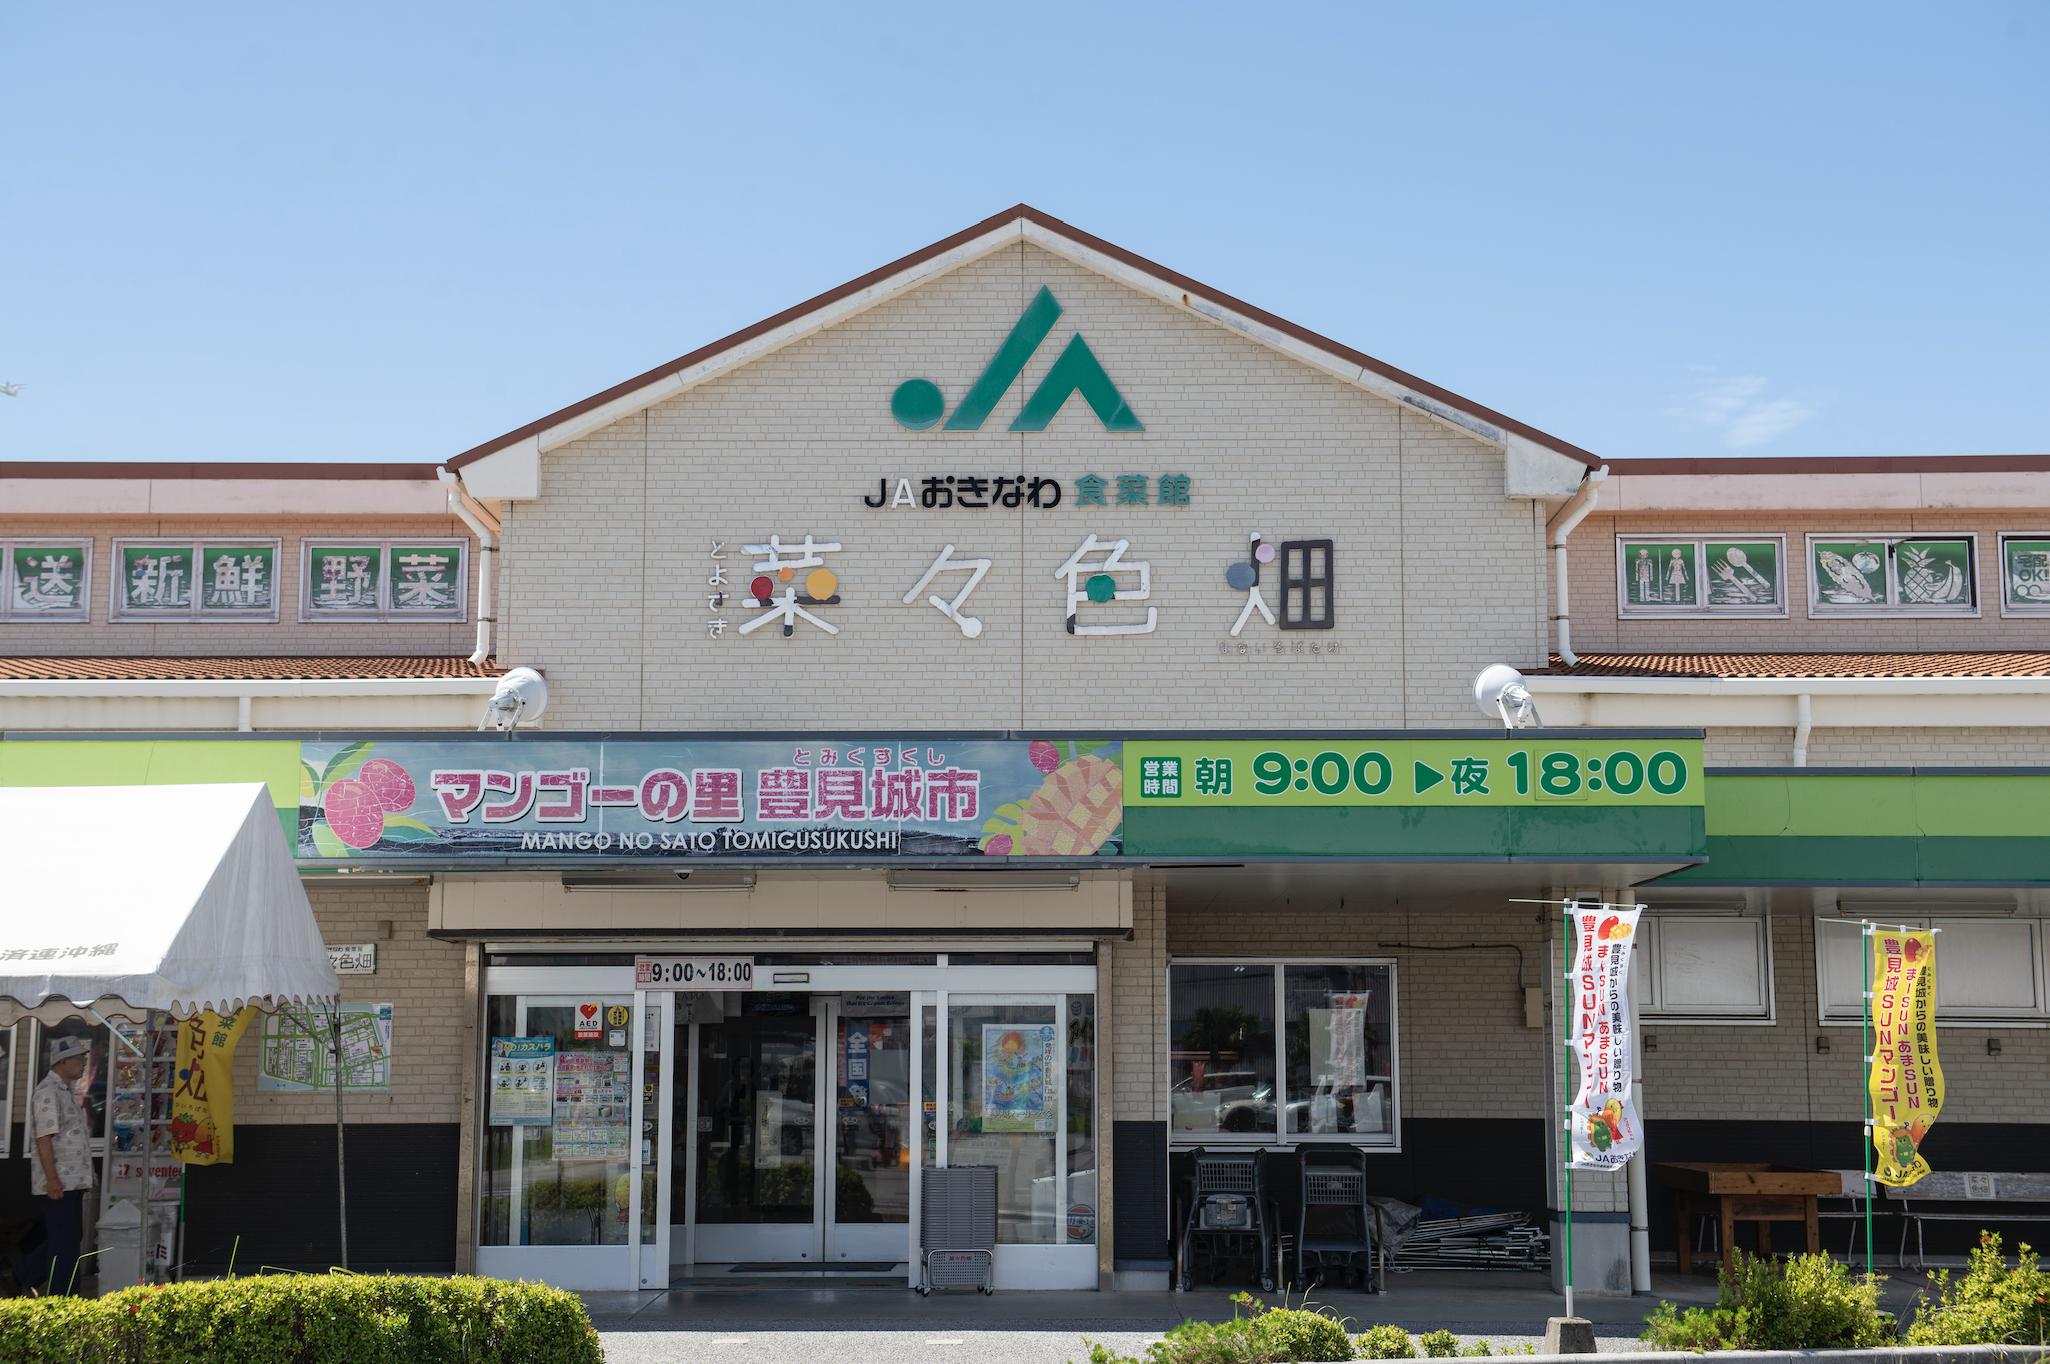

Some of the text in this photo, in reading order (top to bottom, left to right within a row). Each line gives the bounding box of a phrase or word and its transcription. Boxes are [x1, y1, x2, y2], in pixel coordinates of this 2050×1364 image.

[864, 472, 1192, 509] JAおきなわ 食菜館
[130, 553, 264, 605] 新鮮
[320, 553, 449, 604] 野菜
[708, 540, 730, 640] とよさき
[1143, 761, 1178, 777] 営業
[1143, 778, 1178, 795] 時間
[1195, 751, 1688, 796] 朝 9:00 夜 18:00
[431, 767, 981, 823] マンゴーの里 豊見城市
[521, 831, 897, 852] MANGO NO SATO TOMIGUSUKUSHI
